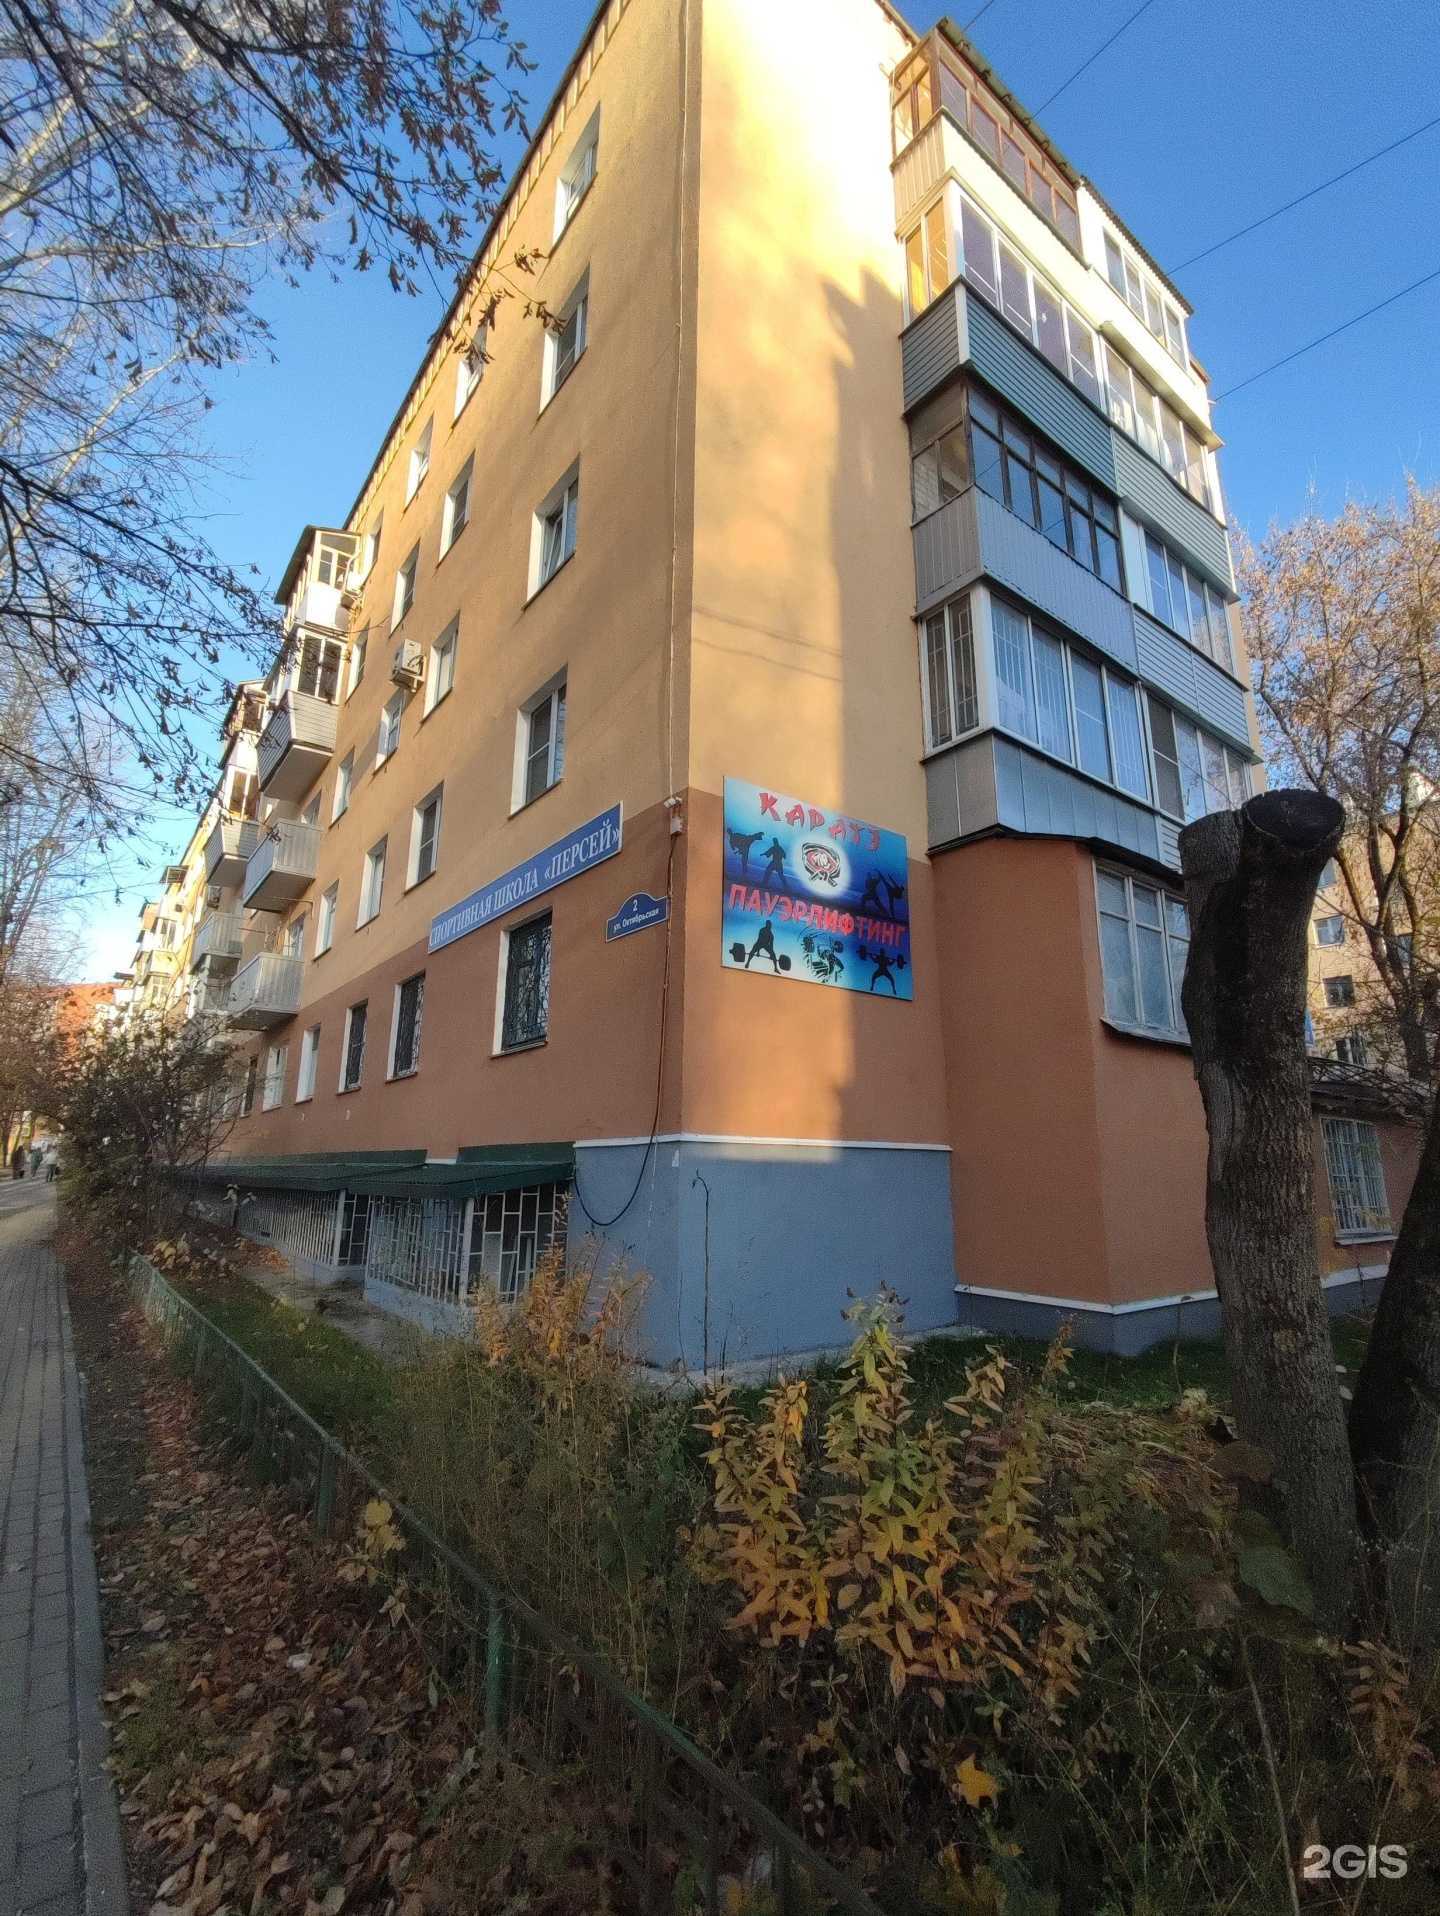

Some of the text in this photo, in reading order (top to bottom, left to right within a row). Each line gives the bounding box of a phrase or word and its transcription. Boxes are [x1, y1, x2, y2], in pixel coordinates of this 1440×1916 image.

[759, 792, 881, 852] КАРАТЭ
[430, 818, 620, 947] СПОРТИВНАЯ ШКОЛА «ПЕРСЕЙ»
[632, 899, 638, 912] 2
[728, 883, 907, 947] ПАУЭРЛИФТИНГ
